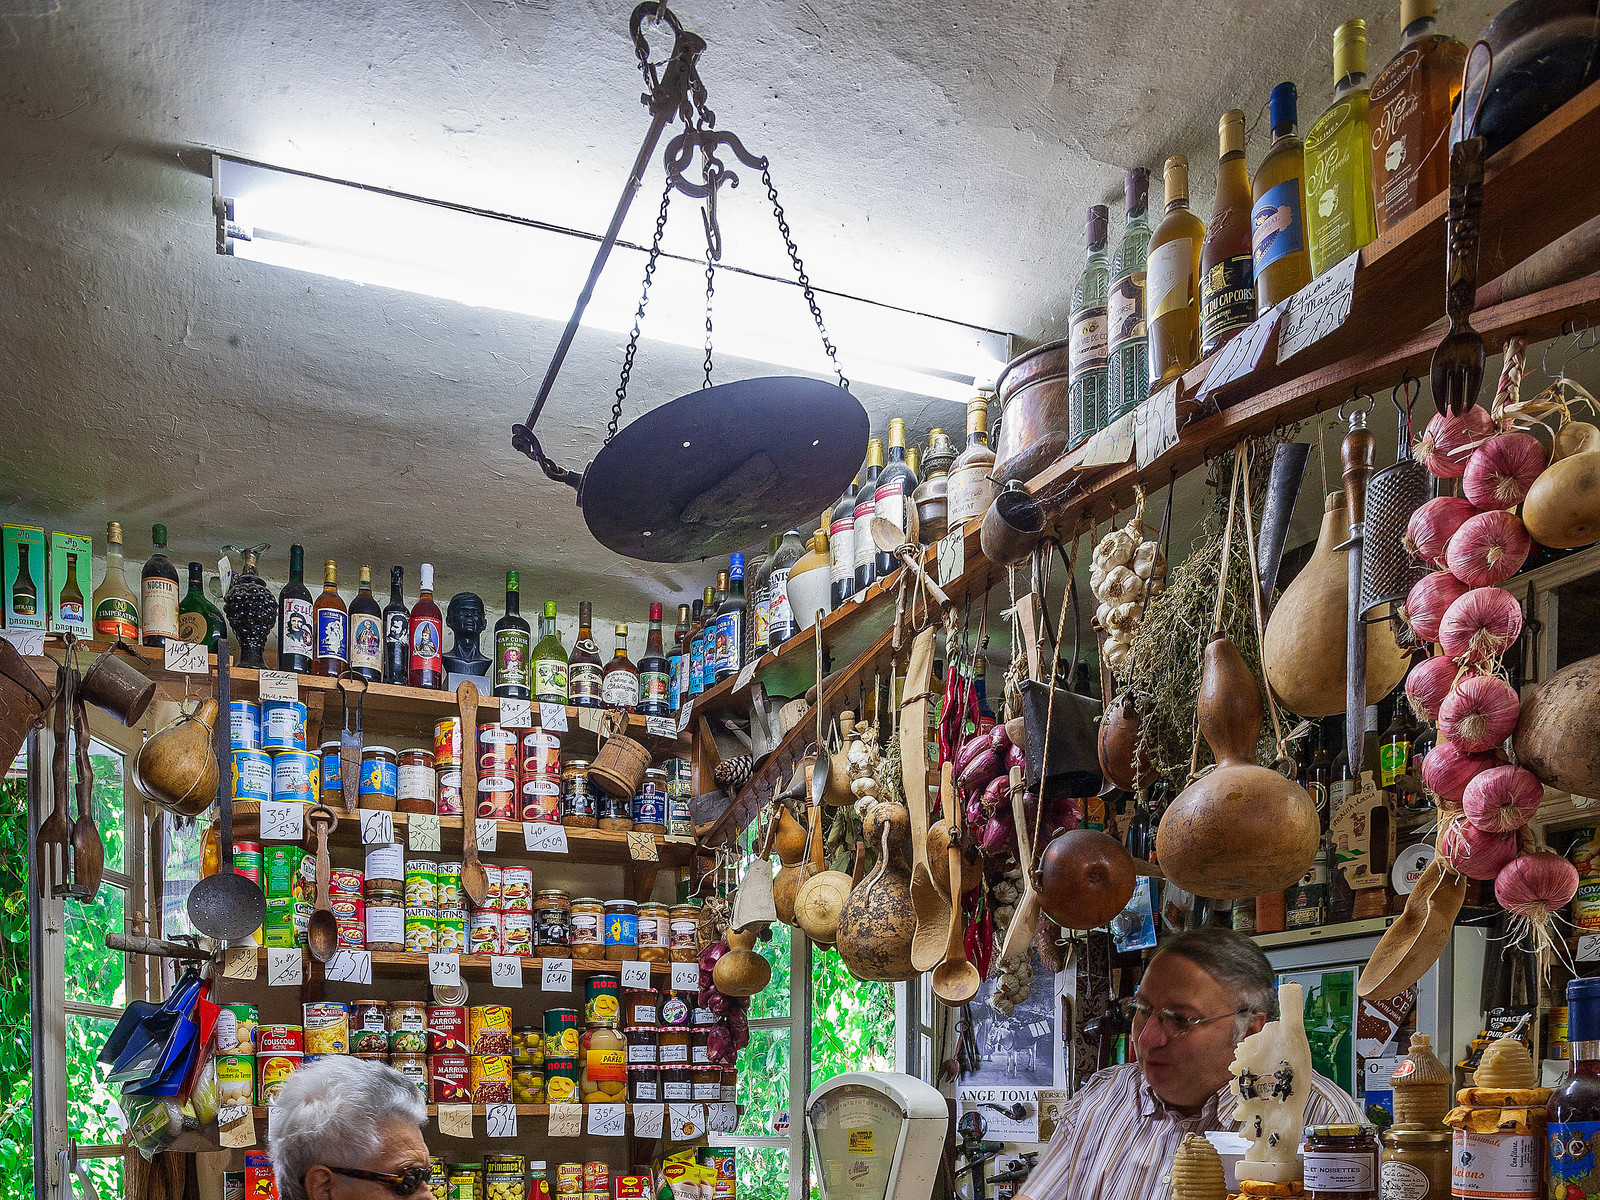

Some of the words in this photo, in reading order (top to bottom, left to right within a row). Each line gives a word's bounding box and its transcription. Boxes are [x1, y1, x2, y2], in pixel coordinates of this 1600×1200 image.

[1219, 292, 1234, 307] CAP
[1578, 884, 1600, 895] ROYA
[593, 980, 617, 989] nora
[263, 1038, 295, 1046] COUSCOUS
[547, 1061, 573, 1070] nora
[959, 1090, 996, 1101] ANGE
[488, 1163, 517, 1172] primance
